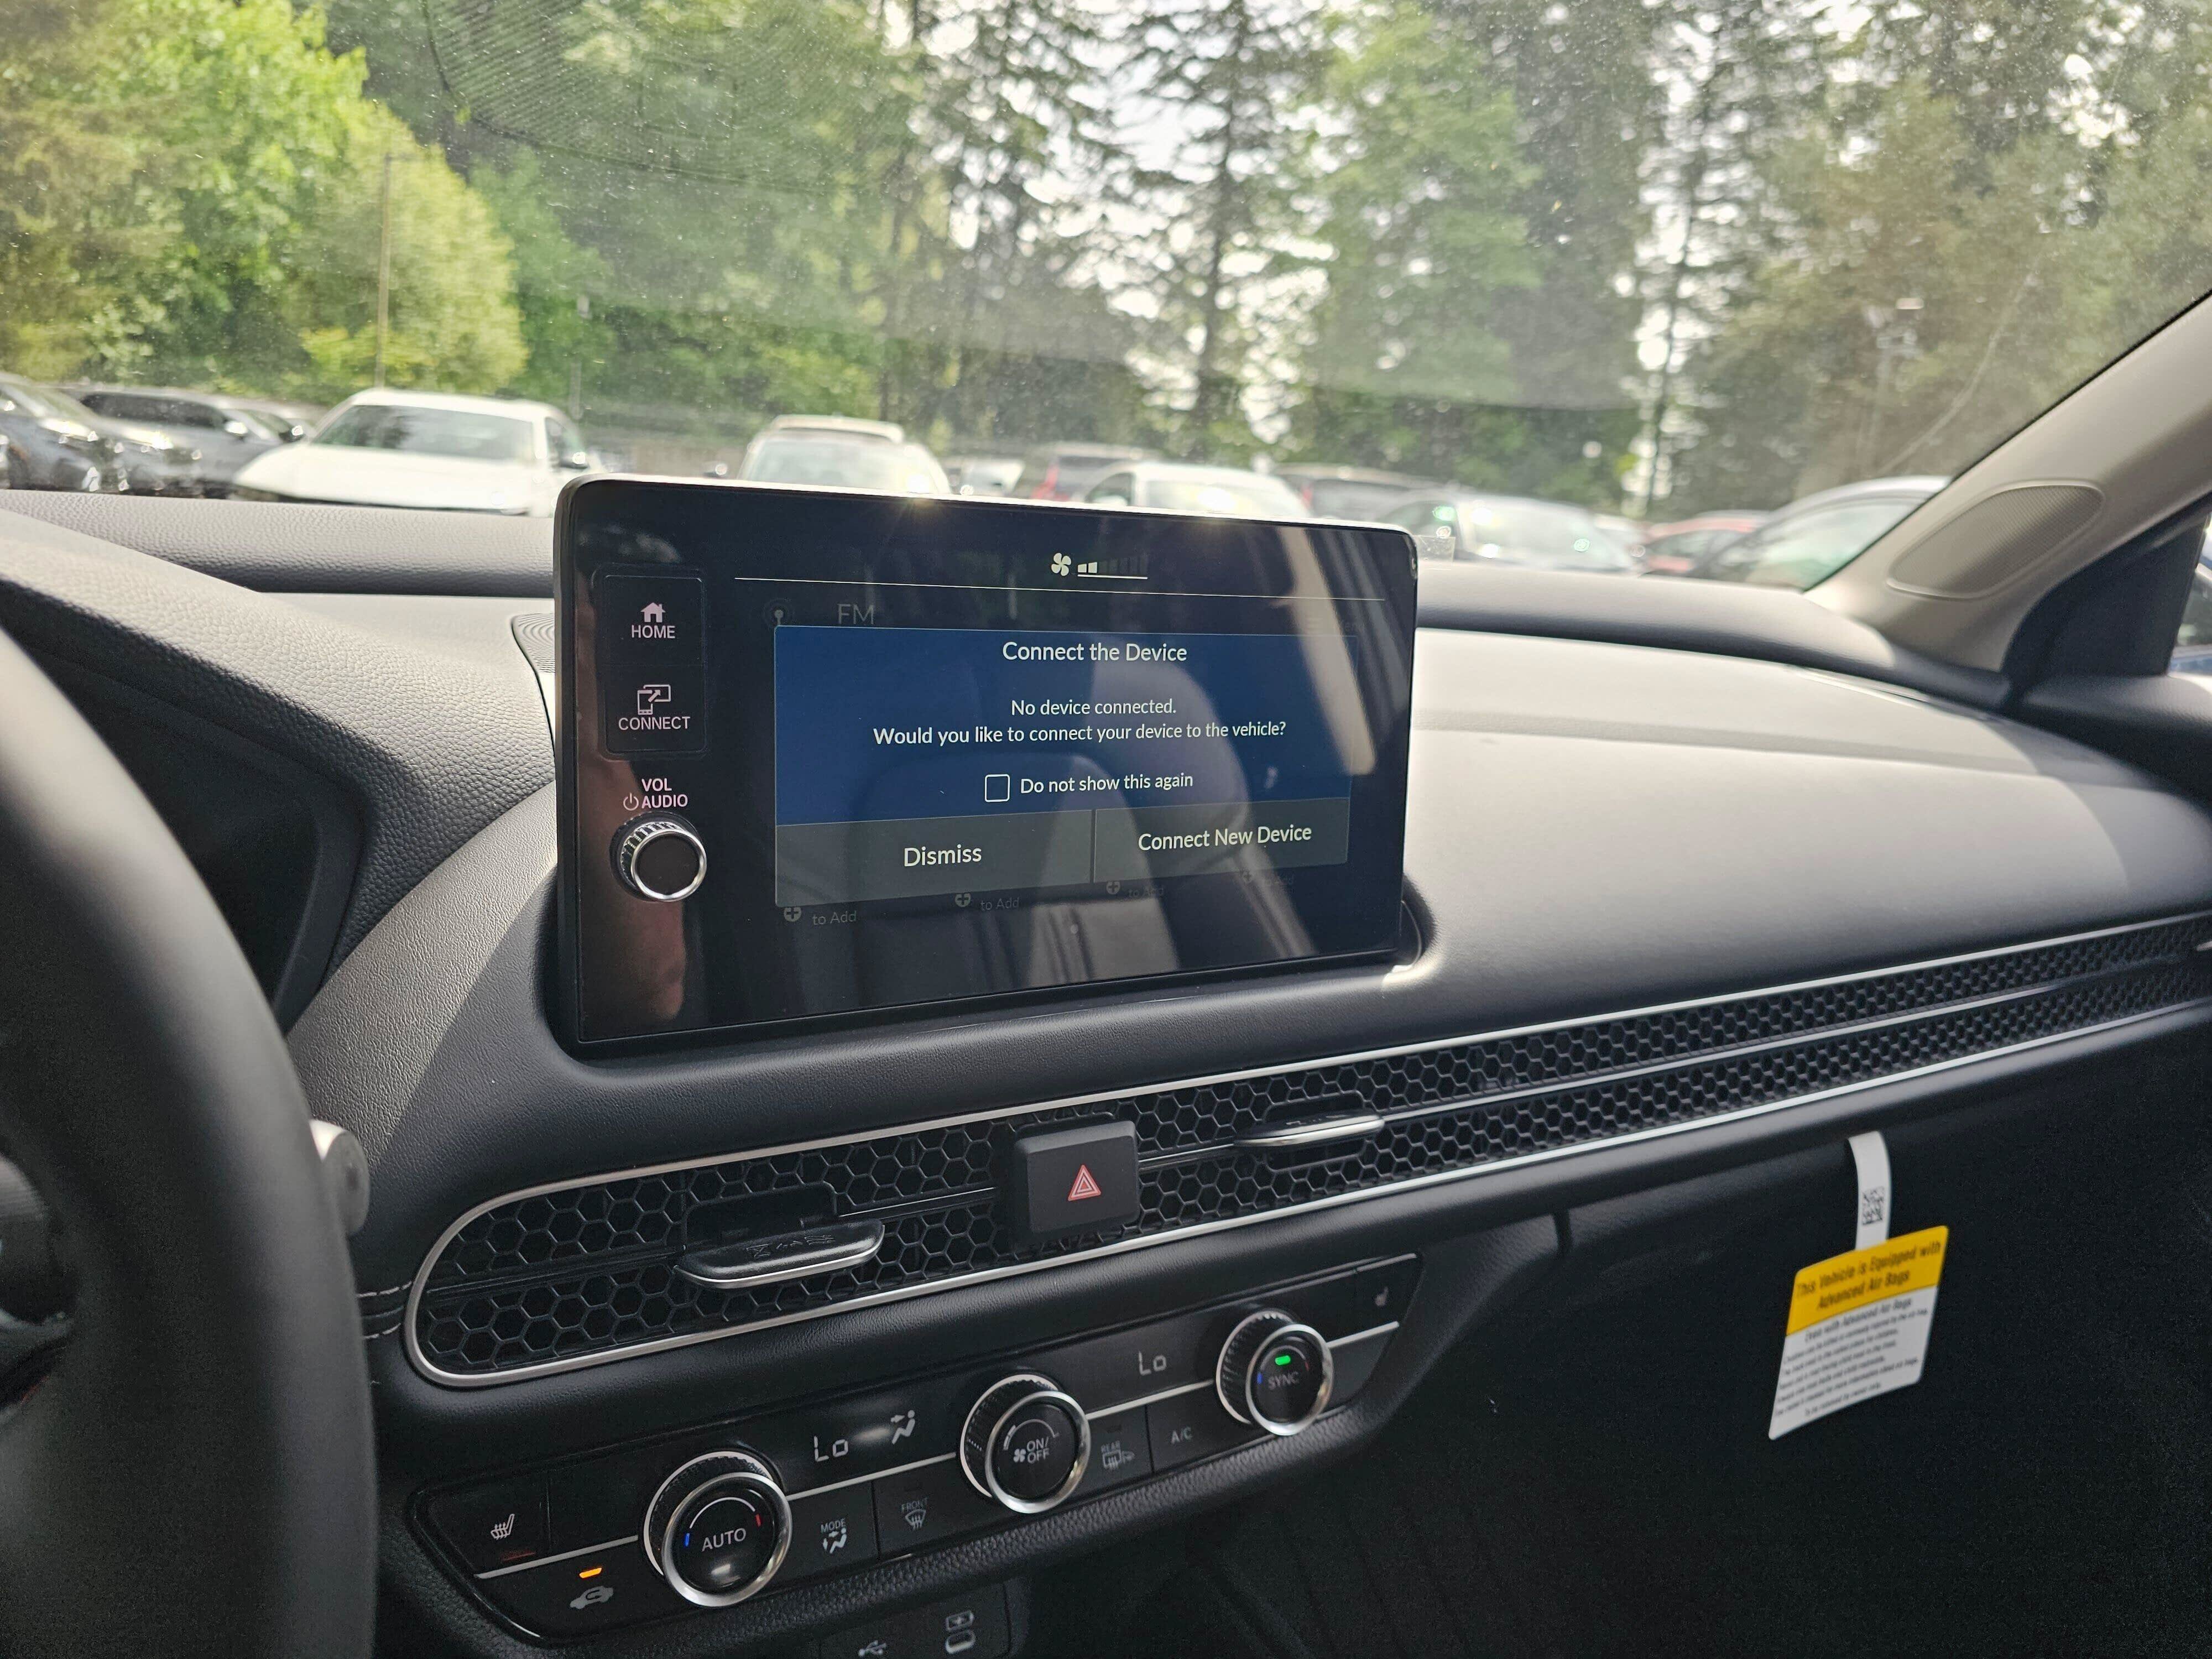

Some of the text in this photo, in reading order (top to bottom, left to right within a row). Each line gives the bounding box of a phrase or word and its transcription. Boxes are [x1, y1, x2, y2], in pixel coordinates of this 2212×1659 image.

[838, 604, 875, 625] FM
[631, 624, 676, 639] HOME
[1002, 641, 1188, 662] Connect the Device
[1011, 698, 1177, 716] No device connected.
[618, 716, 691, 731] CONNECT
[873, 721, 1286, 747] Would you like to connect your device to the vehicle?
[641, 778, 672, 792] VOL
[1021, 773, 1193, 794] Do not show this again
[641, 794, 688, 809] AUDIO
[1138, 824, 1312, 851] Connect New Device
[903, 844, 982, 867] Dismiss
[980, 897, 1020, 911] to Add
[812, 911, 857, 926] to Add
[1796, 1241, 1942, 1298] This Vehicle is Equipped with
[1817, 1270, 1911, 1310] Advanced Air Bags
[1138, 1350, 1167, 1376] Lo
[1026, 1437, 1049, 1452] ON/
[1170, 1426, 1192, 1445] A/C
[813, 1436, 849, 1462] Lo
[1026, 1447, 1050, 1464] OFF
[820, 1517, 846, 1534] MODE
[701, 1527, 747, 1552] AUTO
